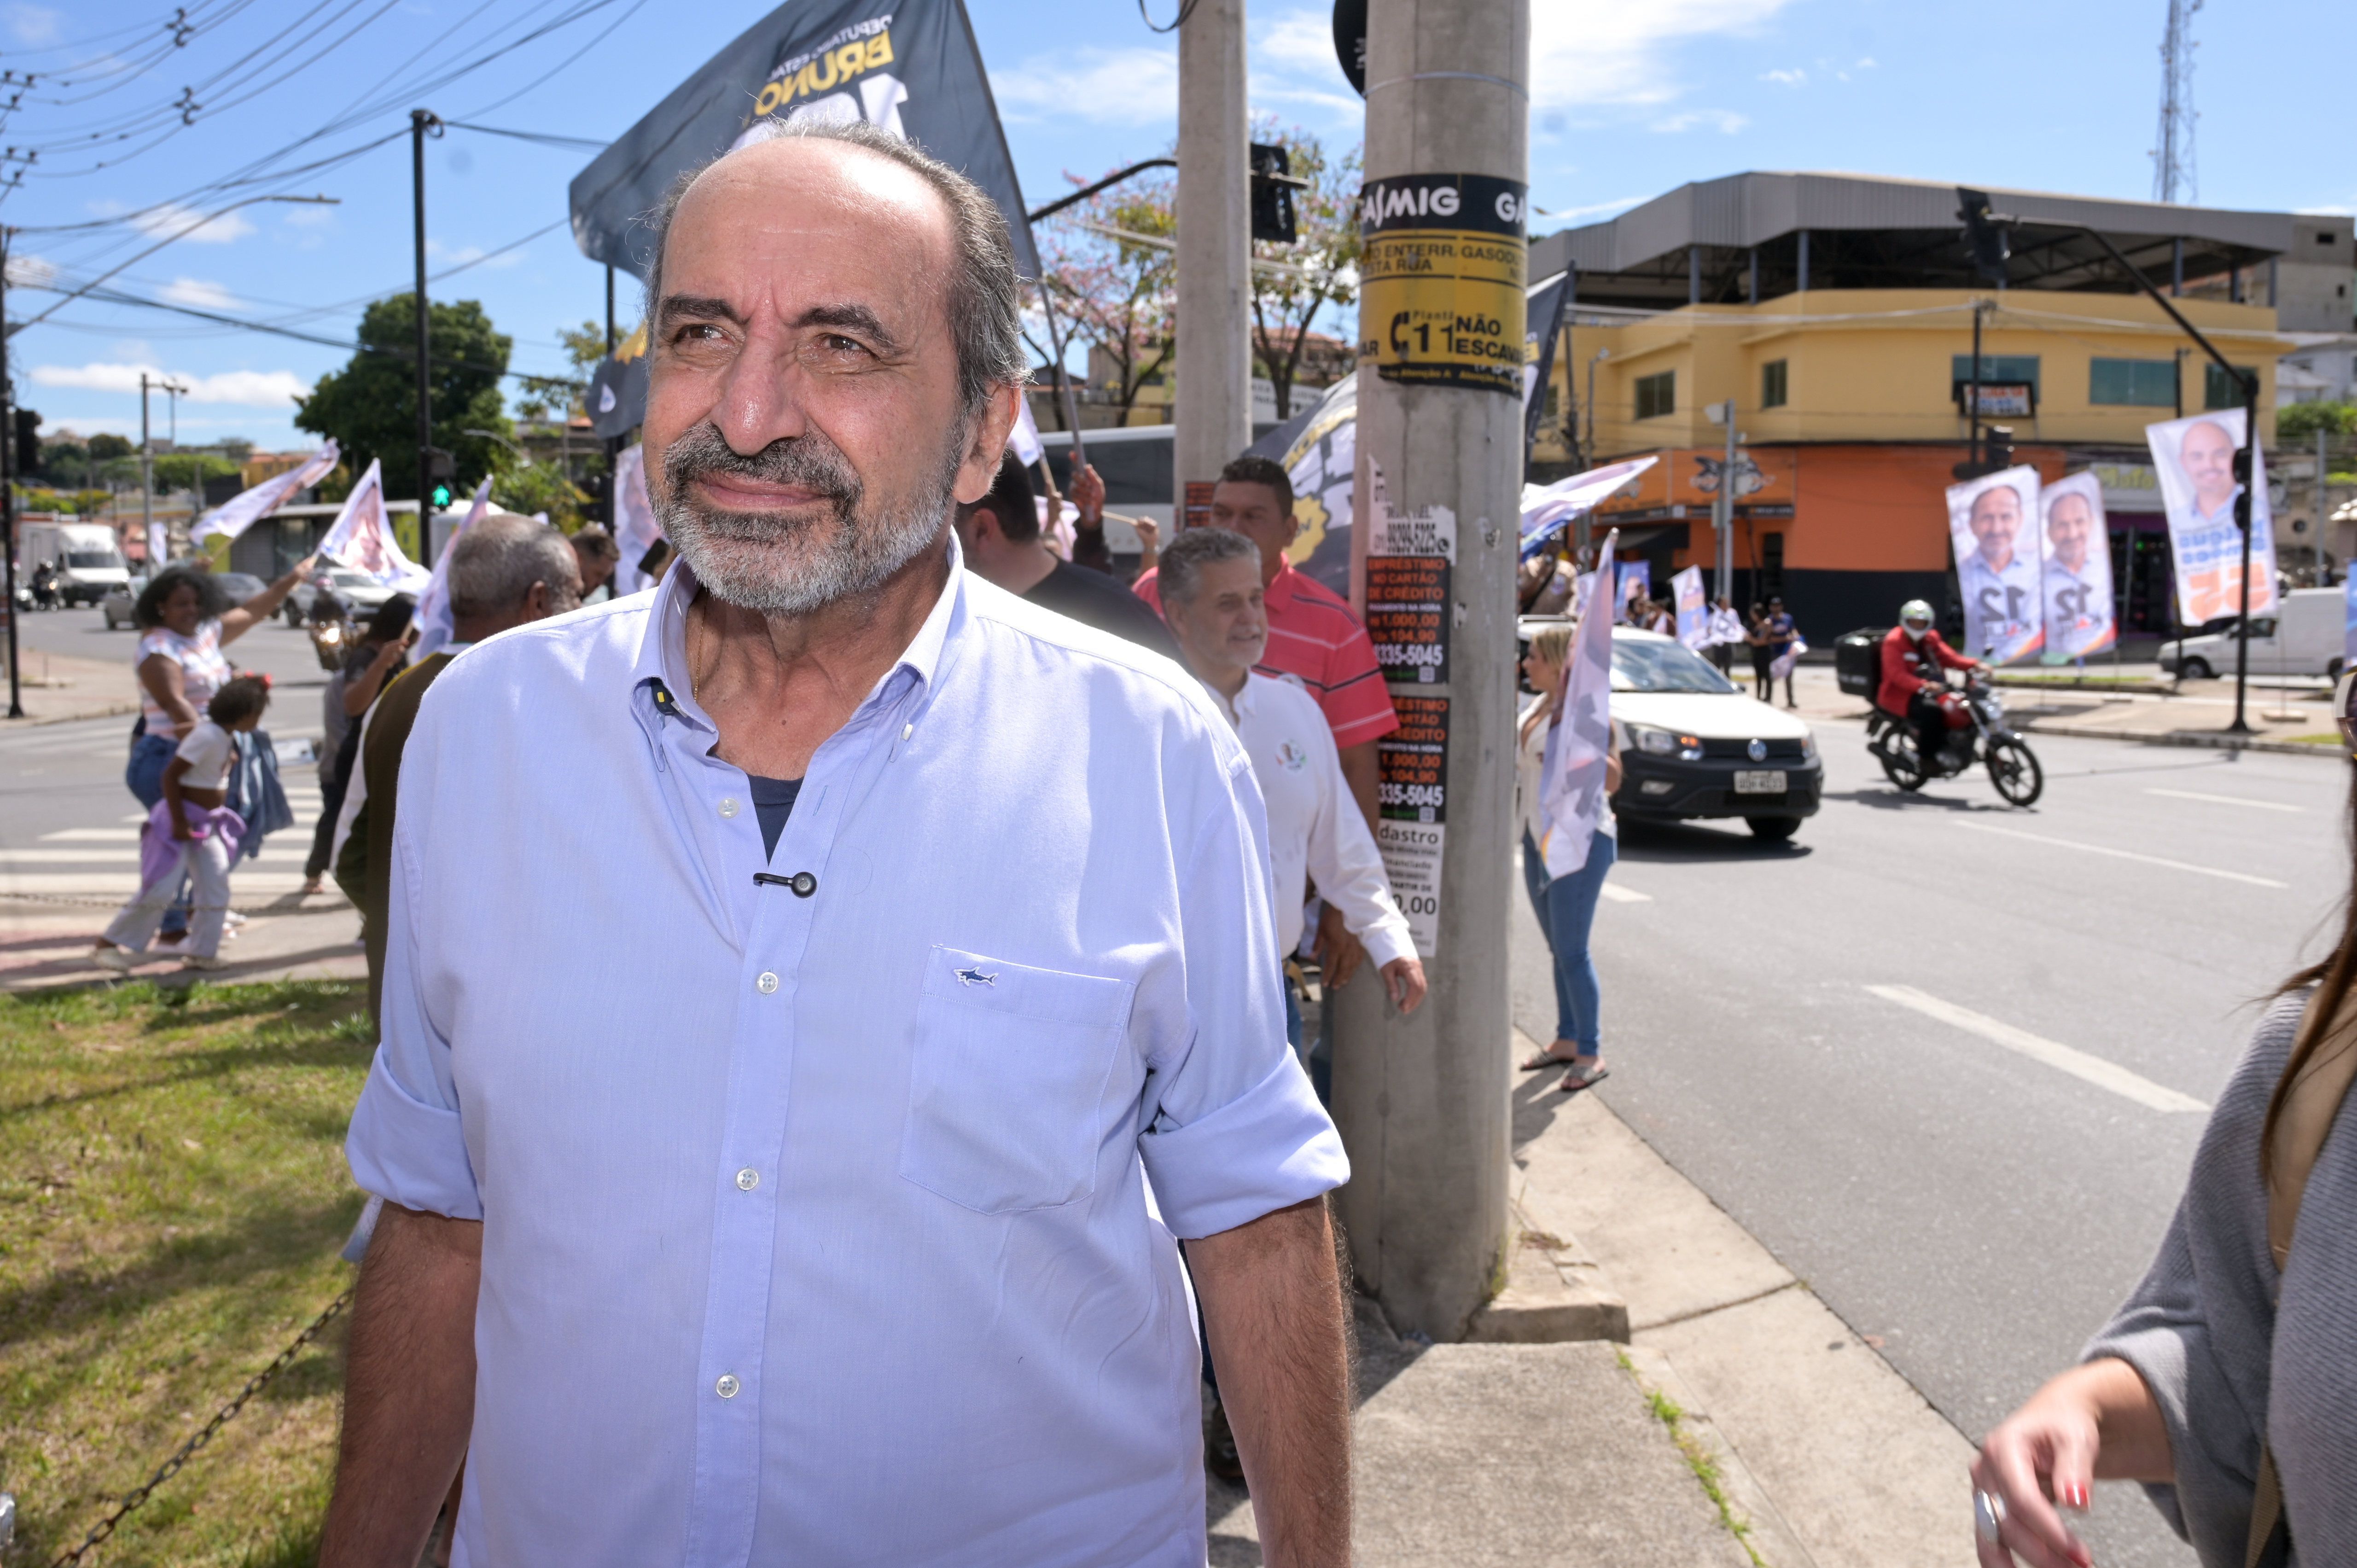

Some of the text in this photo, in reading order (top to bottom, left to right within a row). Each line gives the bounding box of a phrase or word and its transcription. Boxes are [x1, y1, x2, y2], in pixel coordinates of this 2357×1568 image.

[1361, 183, 1460, 229] ASMIG
[1395, 257, 1433, 273] RUA
[1456, 314, 1501, 336] NÃO
[1368, 558, 1446, 571] EMPRÉSTIMO
[1373, 570, 1438, 585] NO CARTÃO
[1385, 583, 1444, 600] CRÉDITO
[1382, 613, 1440, 628] 1.000,00
[1391, 629, 1437, 644] 104,90
[1379, 825, 1438, 844] dastro
